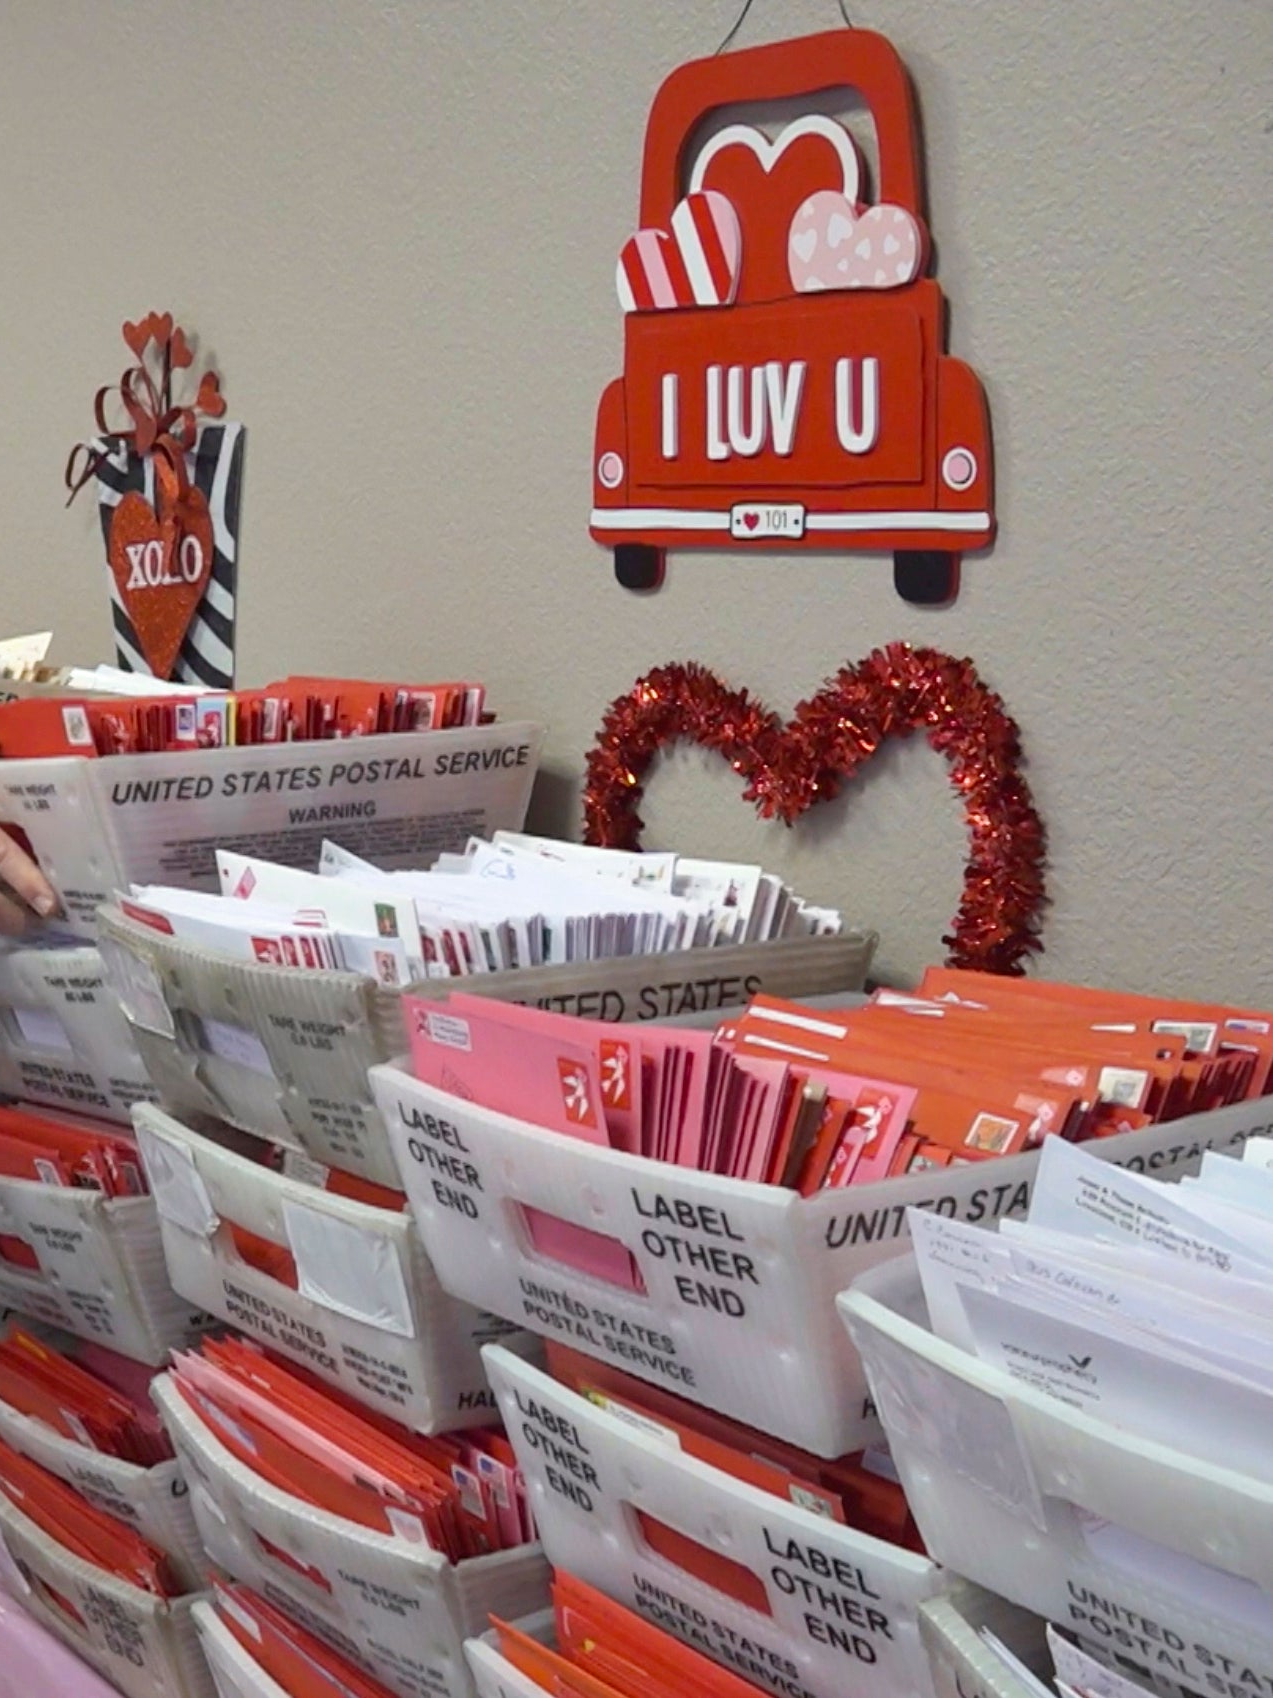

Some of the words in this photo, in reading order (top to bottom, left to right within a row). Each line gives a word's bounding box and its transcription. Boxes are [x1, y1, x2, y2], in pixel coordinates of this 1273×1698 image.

[662, 373, 679, 459] I
[706, 360, 806, 460] LUV
[835, 356, 879, 454] U
[766, 509, 788, 532] 101
[112, 777, 214, 805] UNITED
[222, 765, 324, 796] STATES
[329, 757, 425, 787] POSTAL
[434, 745, 530, 775] SERVICE
[289, 801, 377, 824] WARNING
[398, 1100, 471, 1153] LABEL
[408, 1137, 484, 1193] OTHER
[431, 1178, 478, 1219] END
[631, 1186, 745, 1242] LABEL
[825, 1195, 957, 1249] UNITD
[642, 1229, 760, 1286] OTHER
[222, 1278, 271, 1317] UNITED
[271, 1306, 326, 1349] STATES
[519, 1278, 589, 1320] UNITED
[591, 1309, 677, 1354] STATES
[674, 1275, 745, 1318] END
[226, 1299, 277, 1339] POSTAL
[278, 1328, 340, 1375] SERVICE
[523, 1299, 602, 1347] POSTAL
[603, 1334, 696, 1388] SERVICE
[513, 1386, 590, 1455] LABEL
[522, 1421, 603, 1492] OTHER
[544, 1464, 593, 1512] END
[762, 1525, 882, 1601] LABEL
[633, 1572, 707, 1628] UNITED
[711, 1620, 799, 1680] STATES
[635, 1593, 717, 1653] POSTAL
[771, 1566, 895, 1641] OTHER
[1067, 1580, 1186, 1652] UNITED
[803, 1612, 878, 1665] END
[1068, 1603, 1200, 1683] POSTAL
